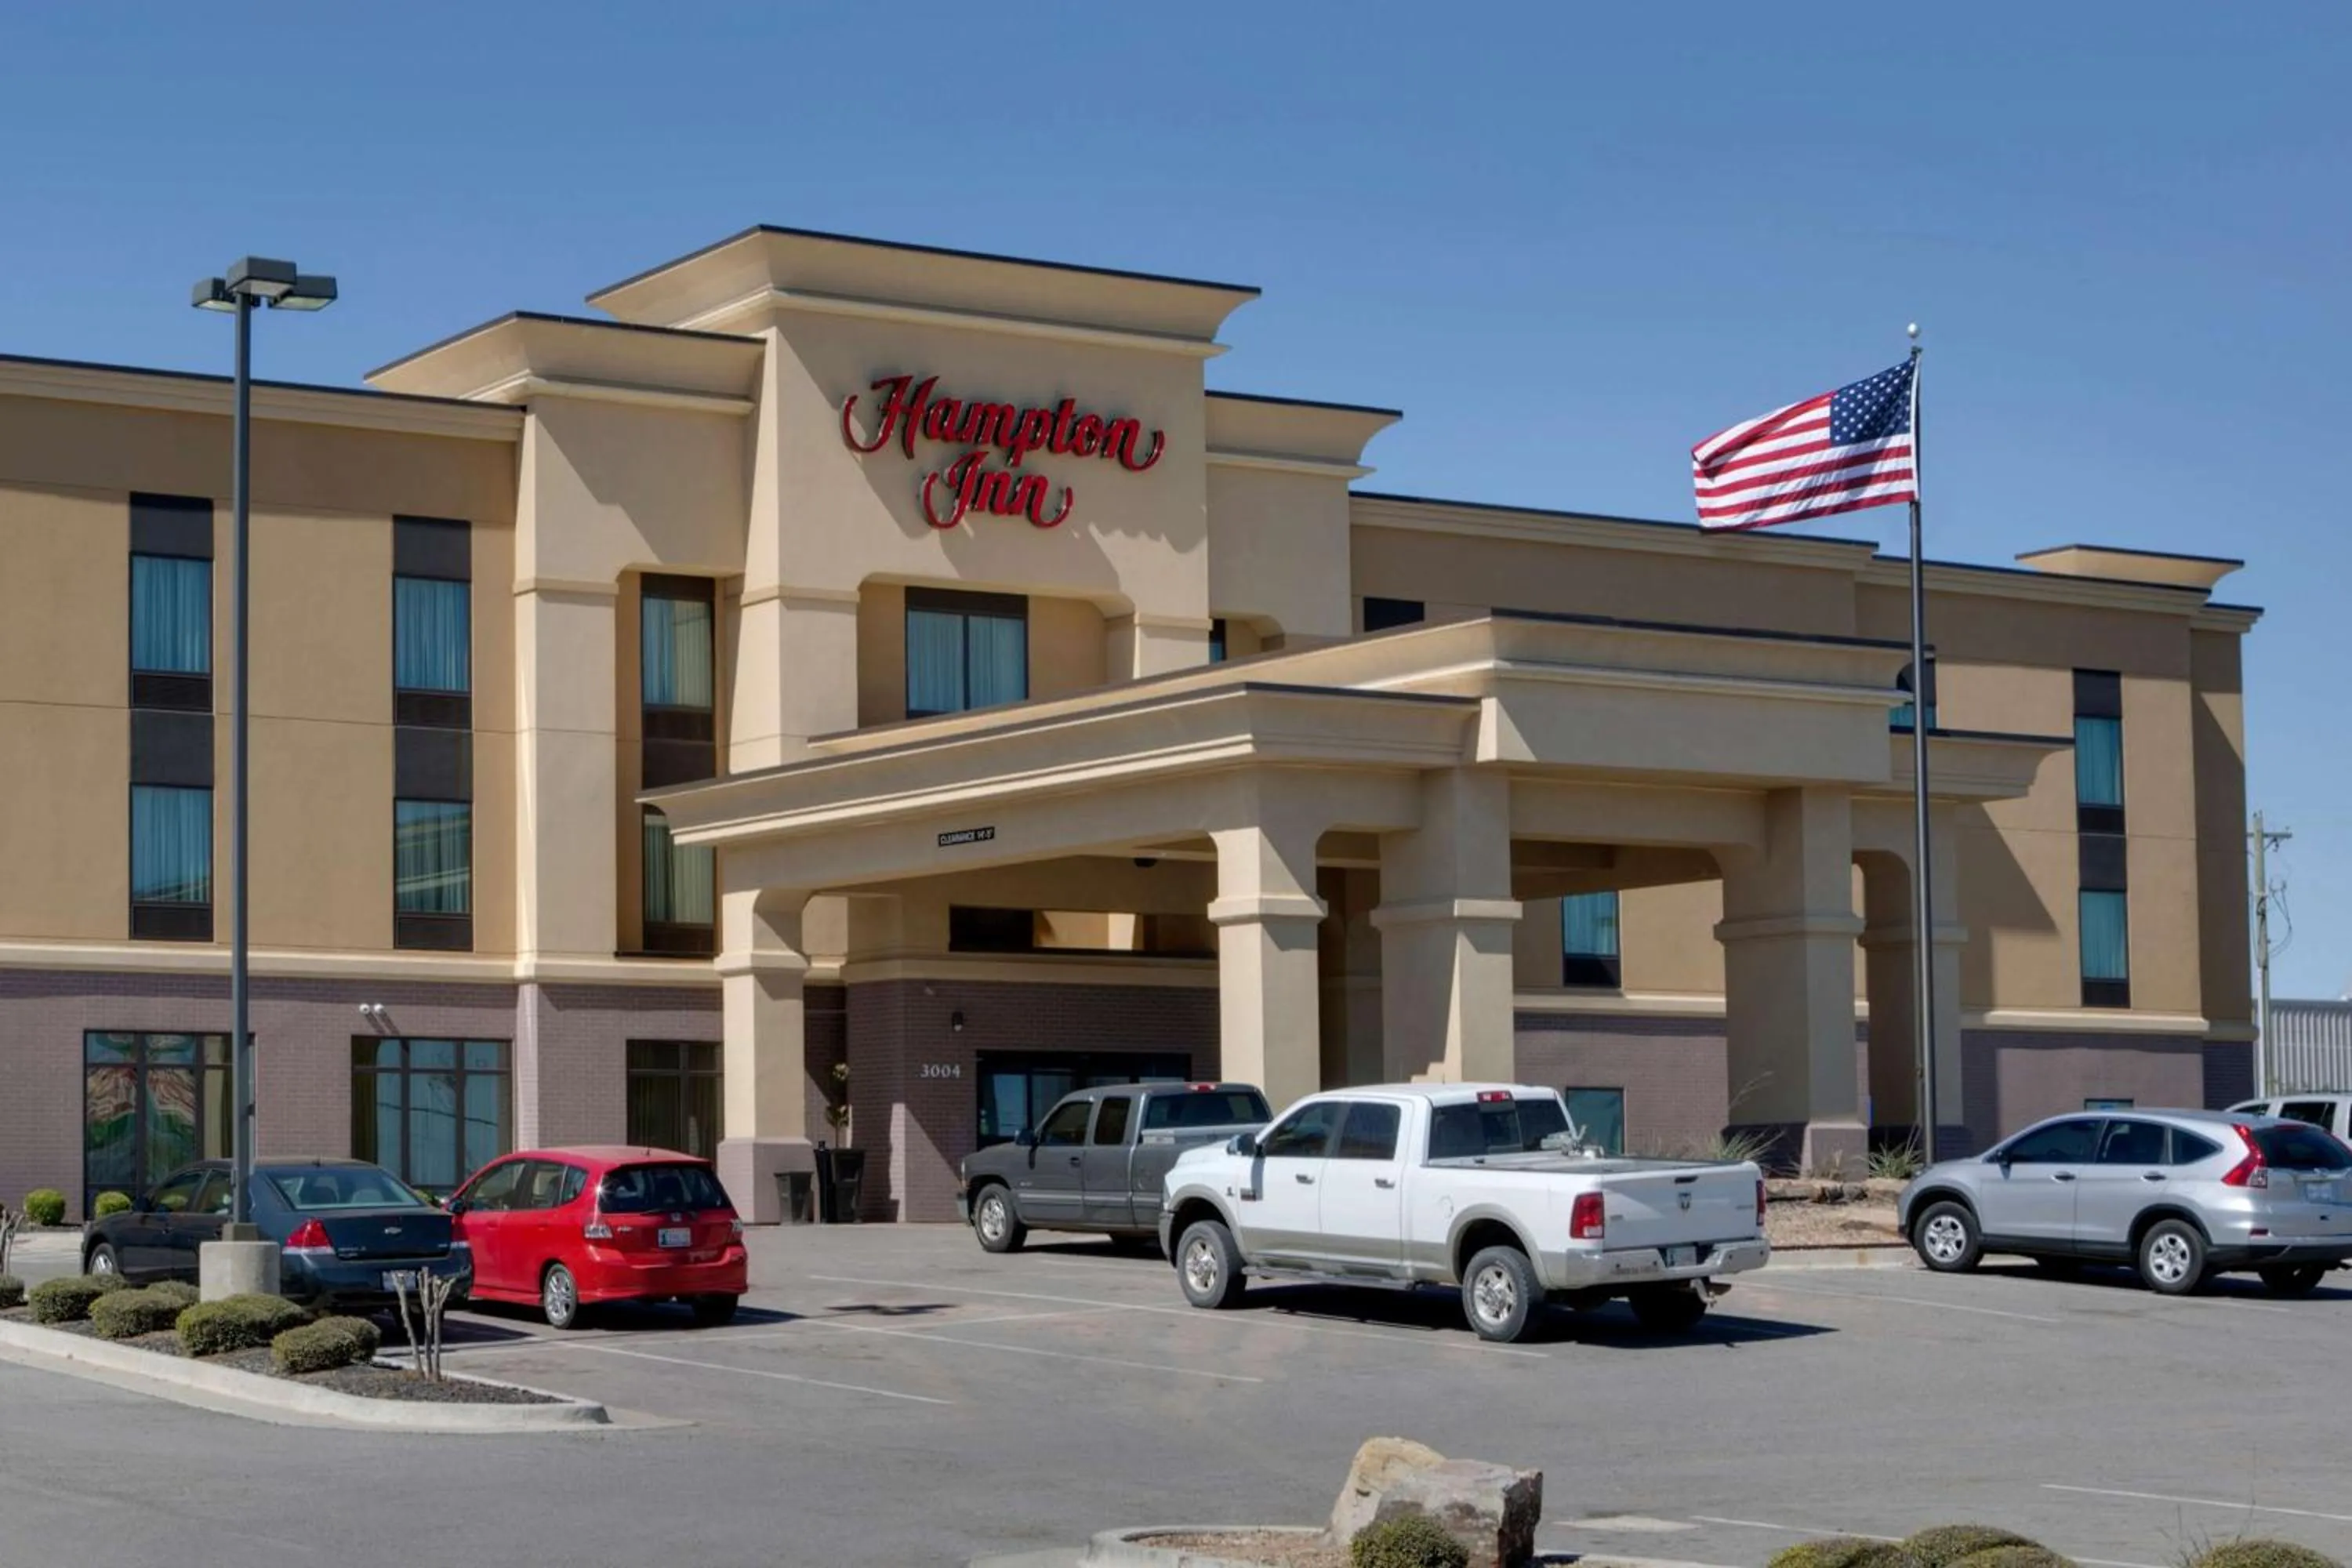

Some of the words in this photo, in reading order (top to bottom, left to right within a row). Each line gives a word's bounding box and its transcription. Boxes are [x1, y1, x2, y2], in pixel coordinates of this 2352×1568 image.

[842, 375, 1166, 472] Hampton
[921, 451, 1073, 528] Inn
[920, 1063, 960, 1079] 3004
